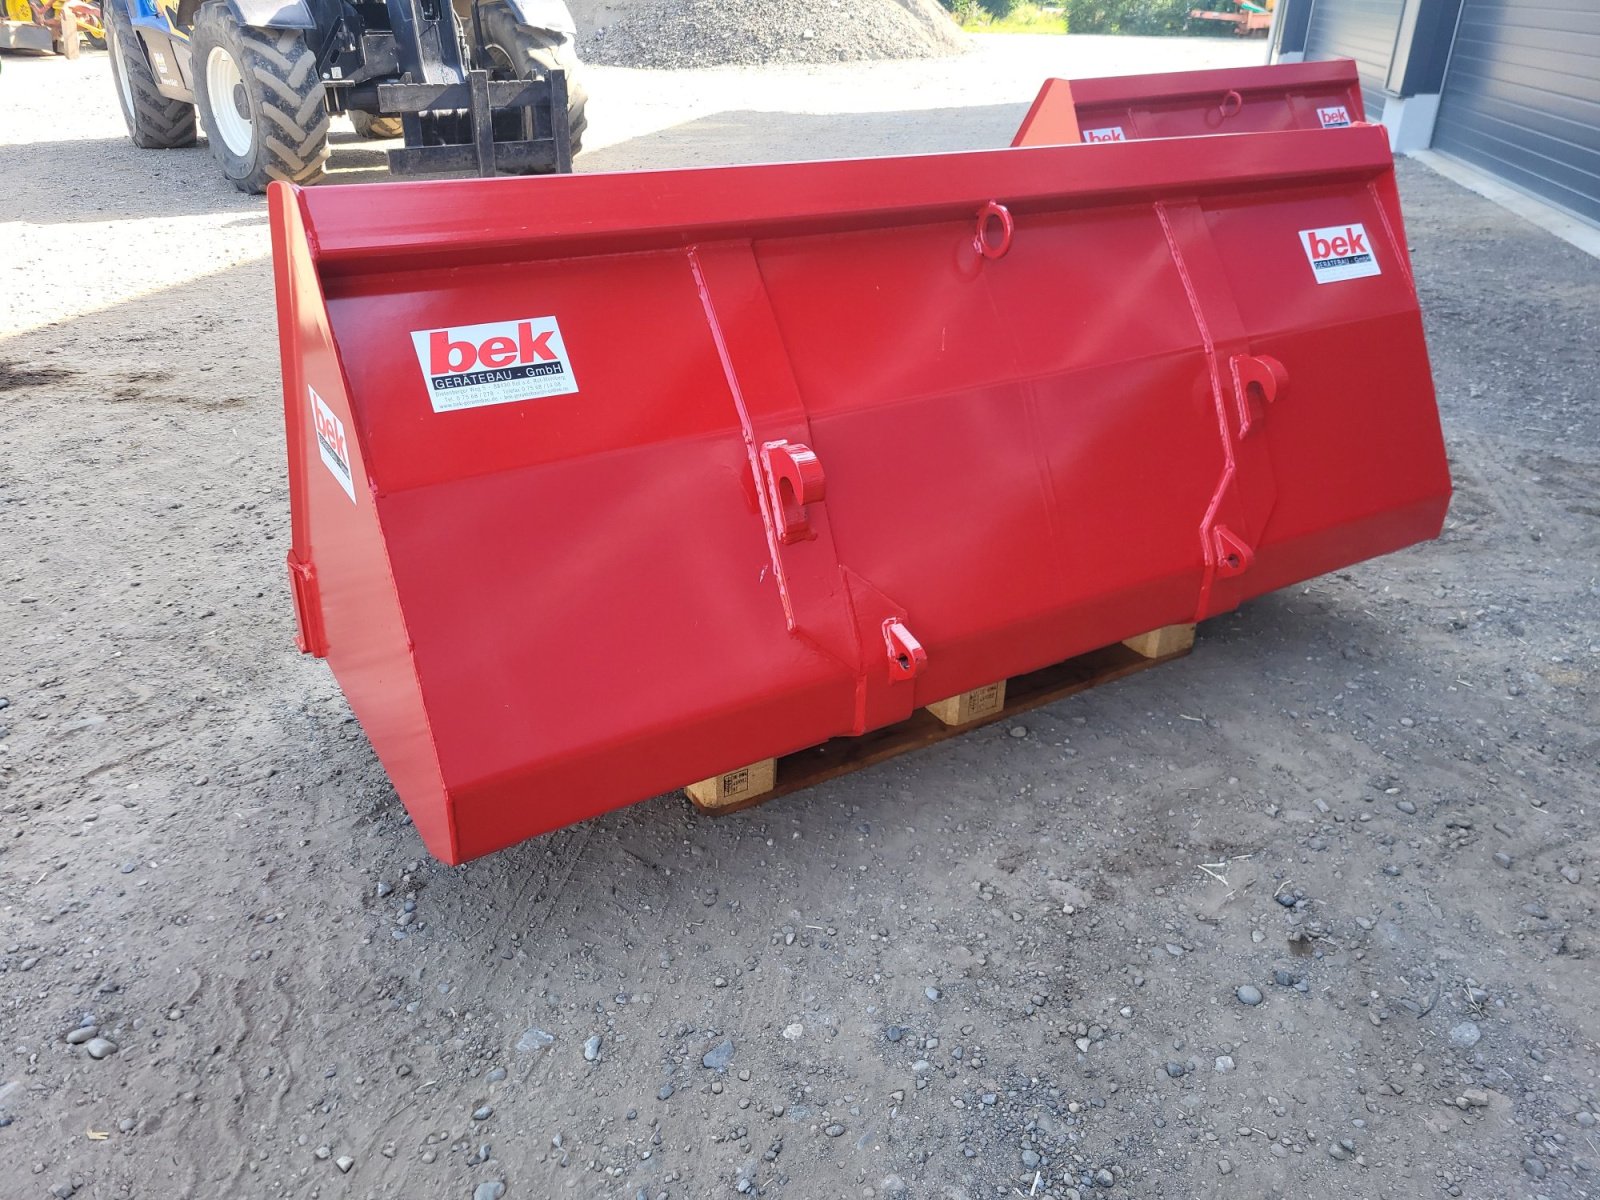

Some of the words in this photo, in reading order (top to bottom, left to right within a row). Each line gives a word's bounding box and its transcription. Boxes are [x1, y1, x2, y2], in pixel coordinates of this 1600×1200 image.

[1321, 109, 1346, 123] bek
[1308, 228, 1367, 260] bek
[429, 322, 558, 376] bek
[434, 370, 512, 389] GERÄTEBAU
[526, 362, 564, 377] GmbH
[313, 392, 347, 465] bek
